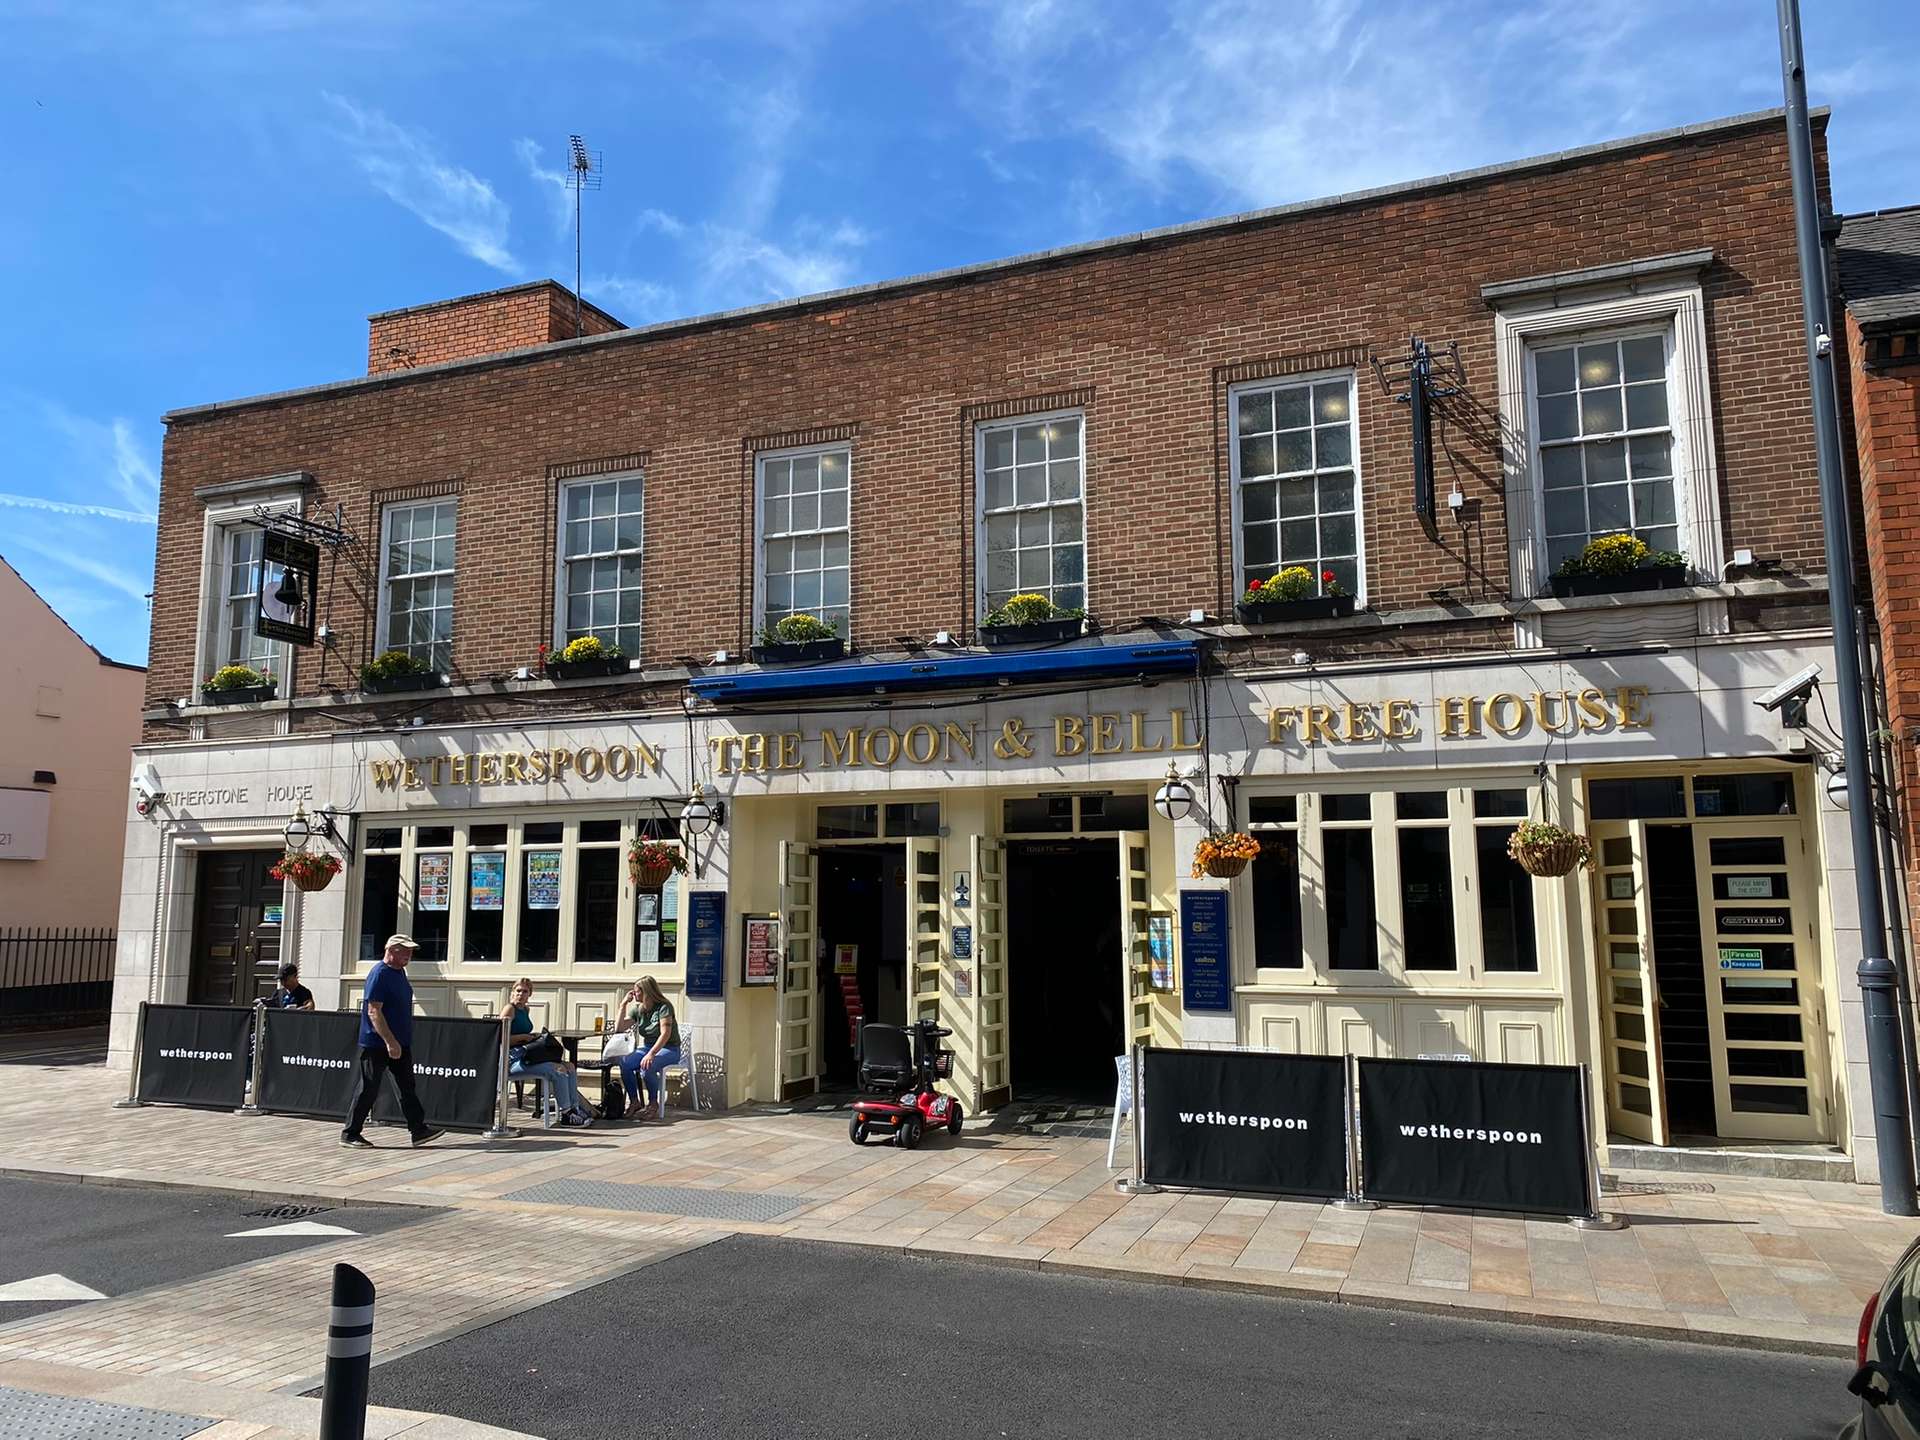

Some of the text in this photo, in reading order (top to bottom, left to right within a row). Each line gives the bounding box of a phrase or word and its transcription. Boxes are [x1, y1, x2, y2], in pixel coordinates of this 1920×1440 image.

[1266, 685, 1655, 745] FREE HOUSE
[708, 708, 1206, 776] THE MOON & BELL
[370, 743, 661, 790] WETHERSPOON
[267, 785, 313, 803] HOUSE
[159, 1047, 233, 1062] wetherspoon
[282, 1054, 351, 1070] wetherspoon
[412, 1063, 477, 1078] therspoon
[1179, 1111, 1308, 1130] wetherspoon
[1399, 1123, 1543, 1144] wetherspoon
